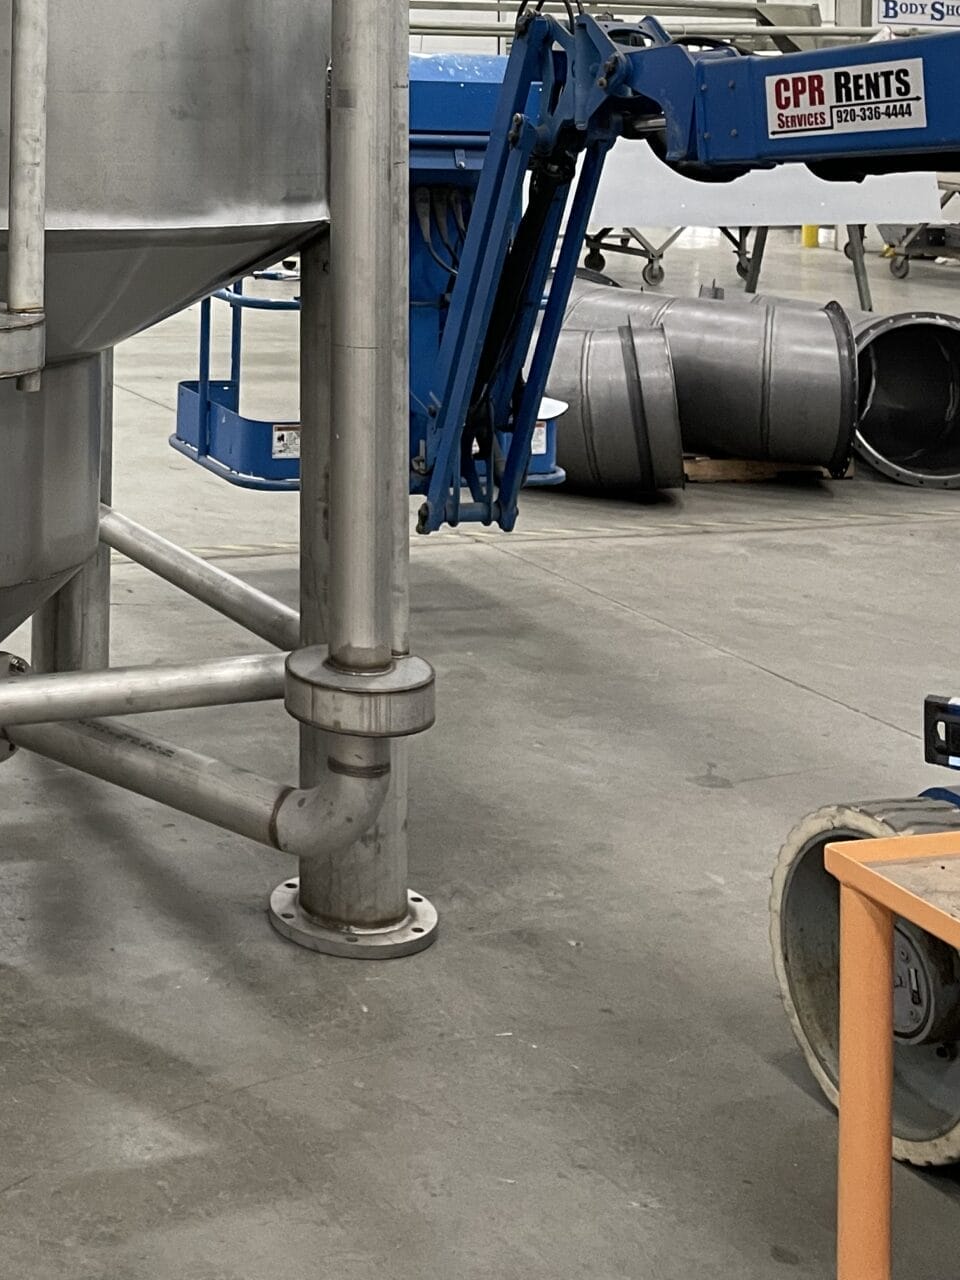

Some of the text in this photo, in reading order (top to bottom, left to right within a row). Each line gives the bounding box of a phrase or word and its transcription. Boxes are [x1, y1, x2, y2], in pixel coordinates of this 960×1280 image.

[774, 68, 911, 110] CPR RENTS
[777, 112, 826, 129] SERVICES
[836, 103, 912, 123] 920-336-4444
